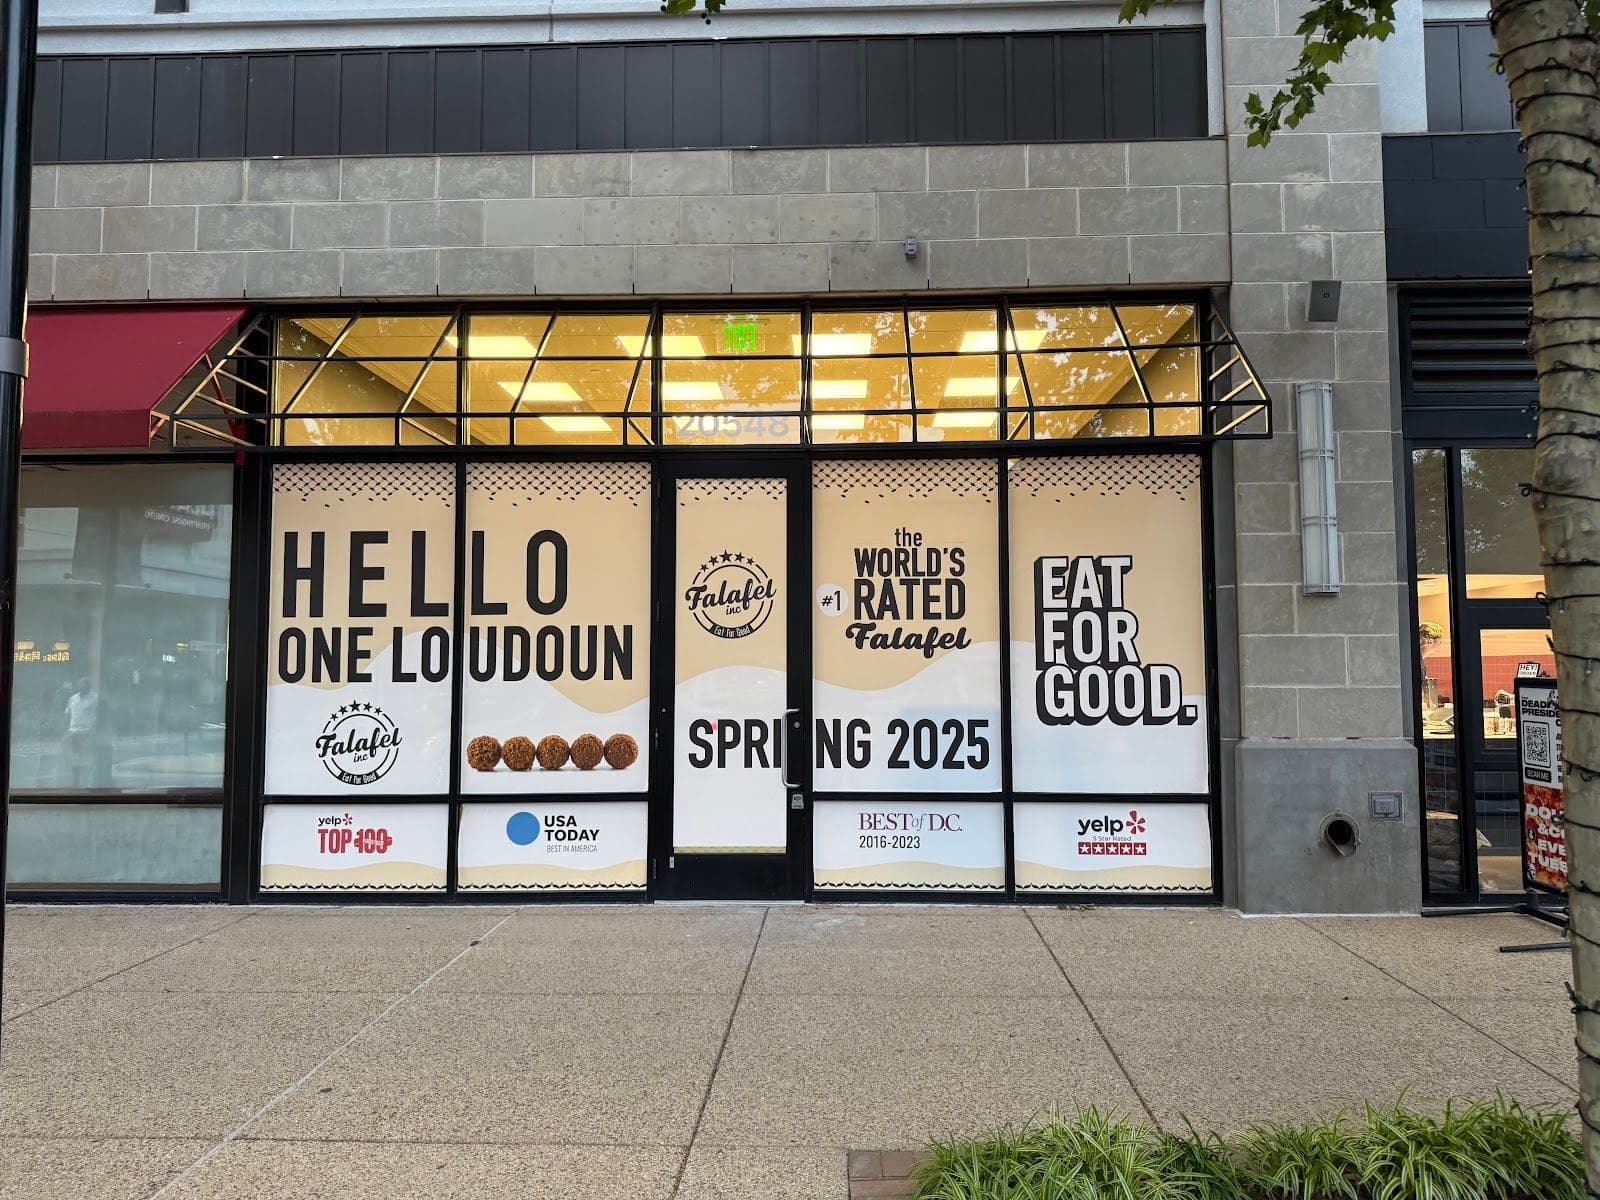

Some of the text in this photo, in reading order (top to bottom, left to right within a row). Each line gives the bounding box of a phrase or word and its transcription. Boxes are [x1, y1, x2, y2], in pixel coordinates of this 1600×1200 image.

[675, 411, 789, 437] 20548
[895, 527, 923, 547] the
[282, 529, 568, 617] HELLO
[854, 547, 966, 577] WORLD'S
[685, 578, 777, 610] Falafel
[1034, 555, 1133, 609] EAT
[726, 605, 741, 615] inc
[820, 578, 966, 620] #1 RATED
[846, 622, 972, 659] Falafel
[1036, 609, 1140, 670] FOR
[278, 624, 633, 683] ONE LOUDOUN
[1036, 663, 1198, 726] GOOD.
[315, 727, 402, 758] Falafel
[688, 718, 990, 770] SPRING 2025
[353, 752, 368, 763] inc
[317, 816, 342, 827] yelp
[544, 815, 577, 827] USA
[859, 812, 963, 832] BEST of D.C.
[1077, 815, 1124, 836] yelp
[318, 828, 393, 854] TOP 100
[544, 829, 600, 841] TODAY
[859, 835, 921, 849] 2016-2023
[547, 845, 598, 853] BEST IN AMERICA
